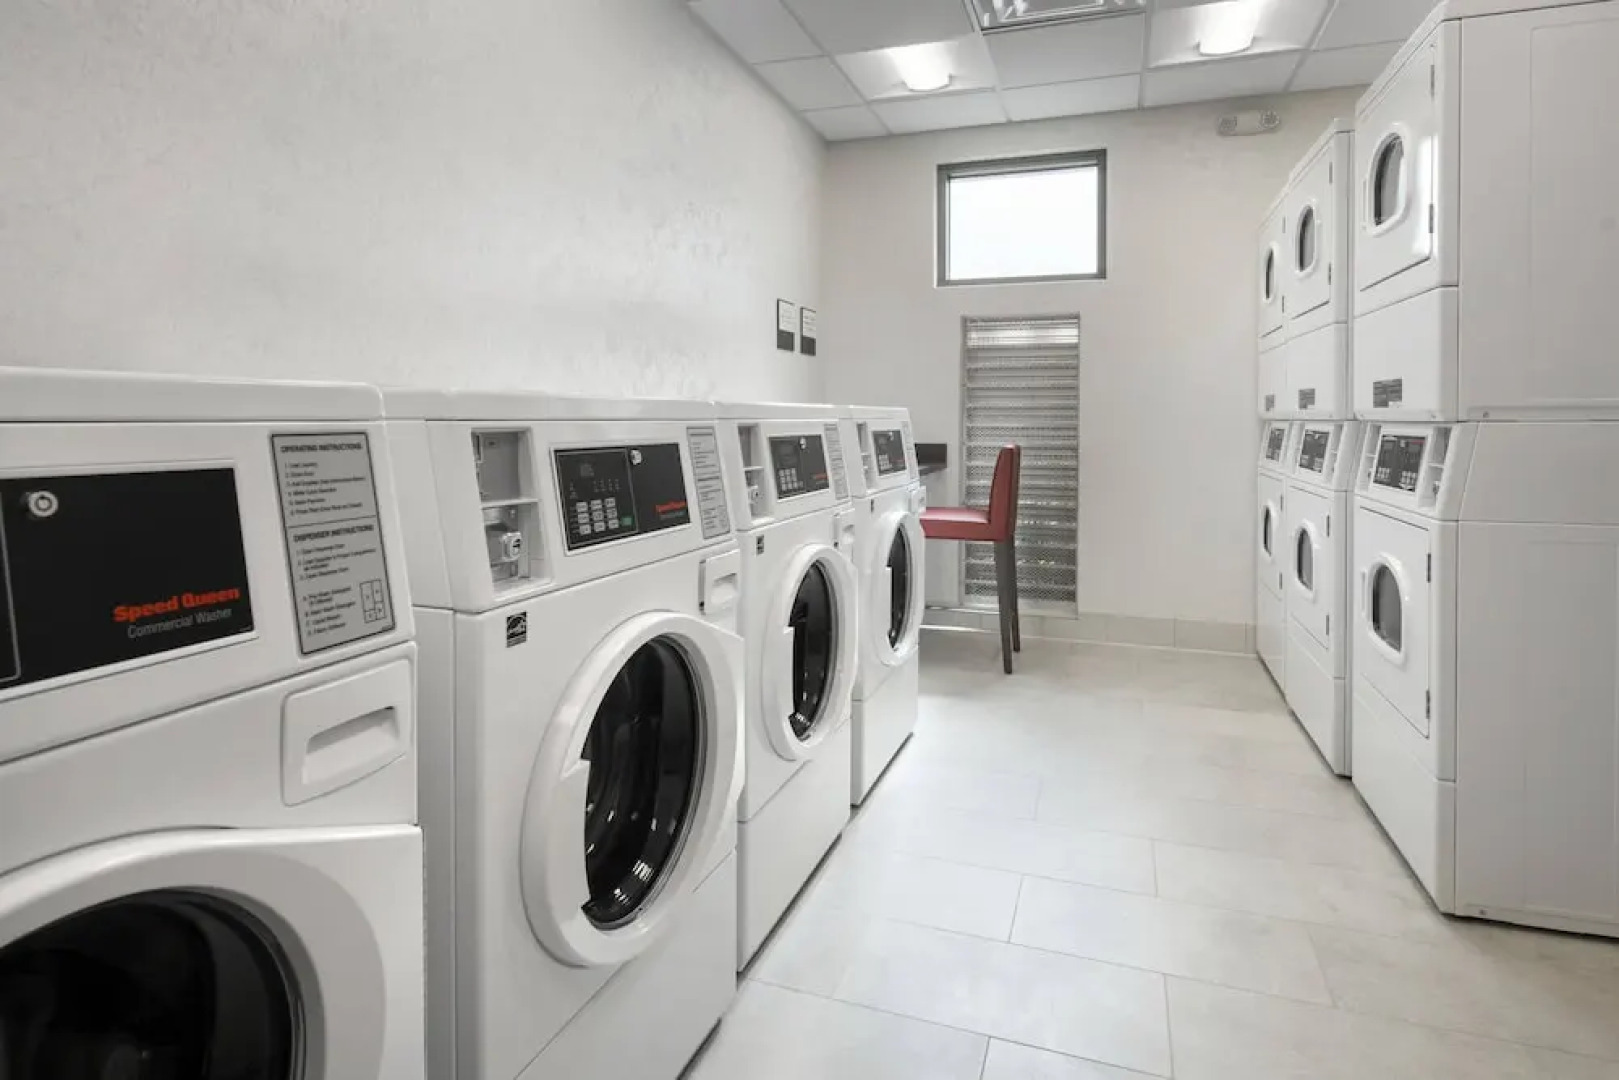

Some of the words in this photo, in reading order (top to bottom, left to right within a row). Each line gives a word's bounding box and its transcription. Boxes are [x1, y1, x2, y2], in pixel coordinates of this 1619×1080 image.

[280, 444, 318, 453] OPERATING
[318, 442, 363, 451] INSTRUCTIONS
[293, 530, 330, 542] DISPENSER
[331, 525, 374, 537] INSTRUCTIONS
[114, 595, 179, 622] Speed
[182, 588, 240, 608] Queen
[127, 615, 194, 639] Commercial
[195, 608, 233, 624] Washer
